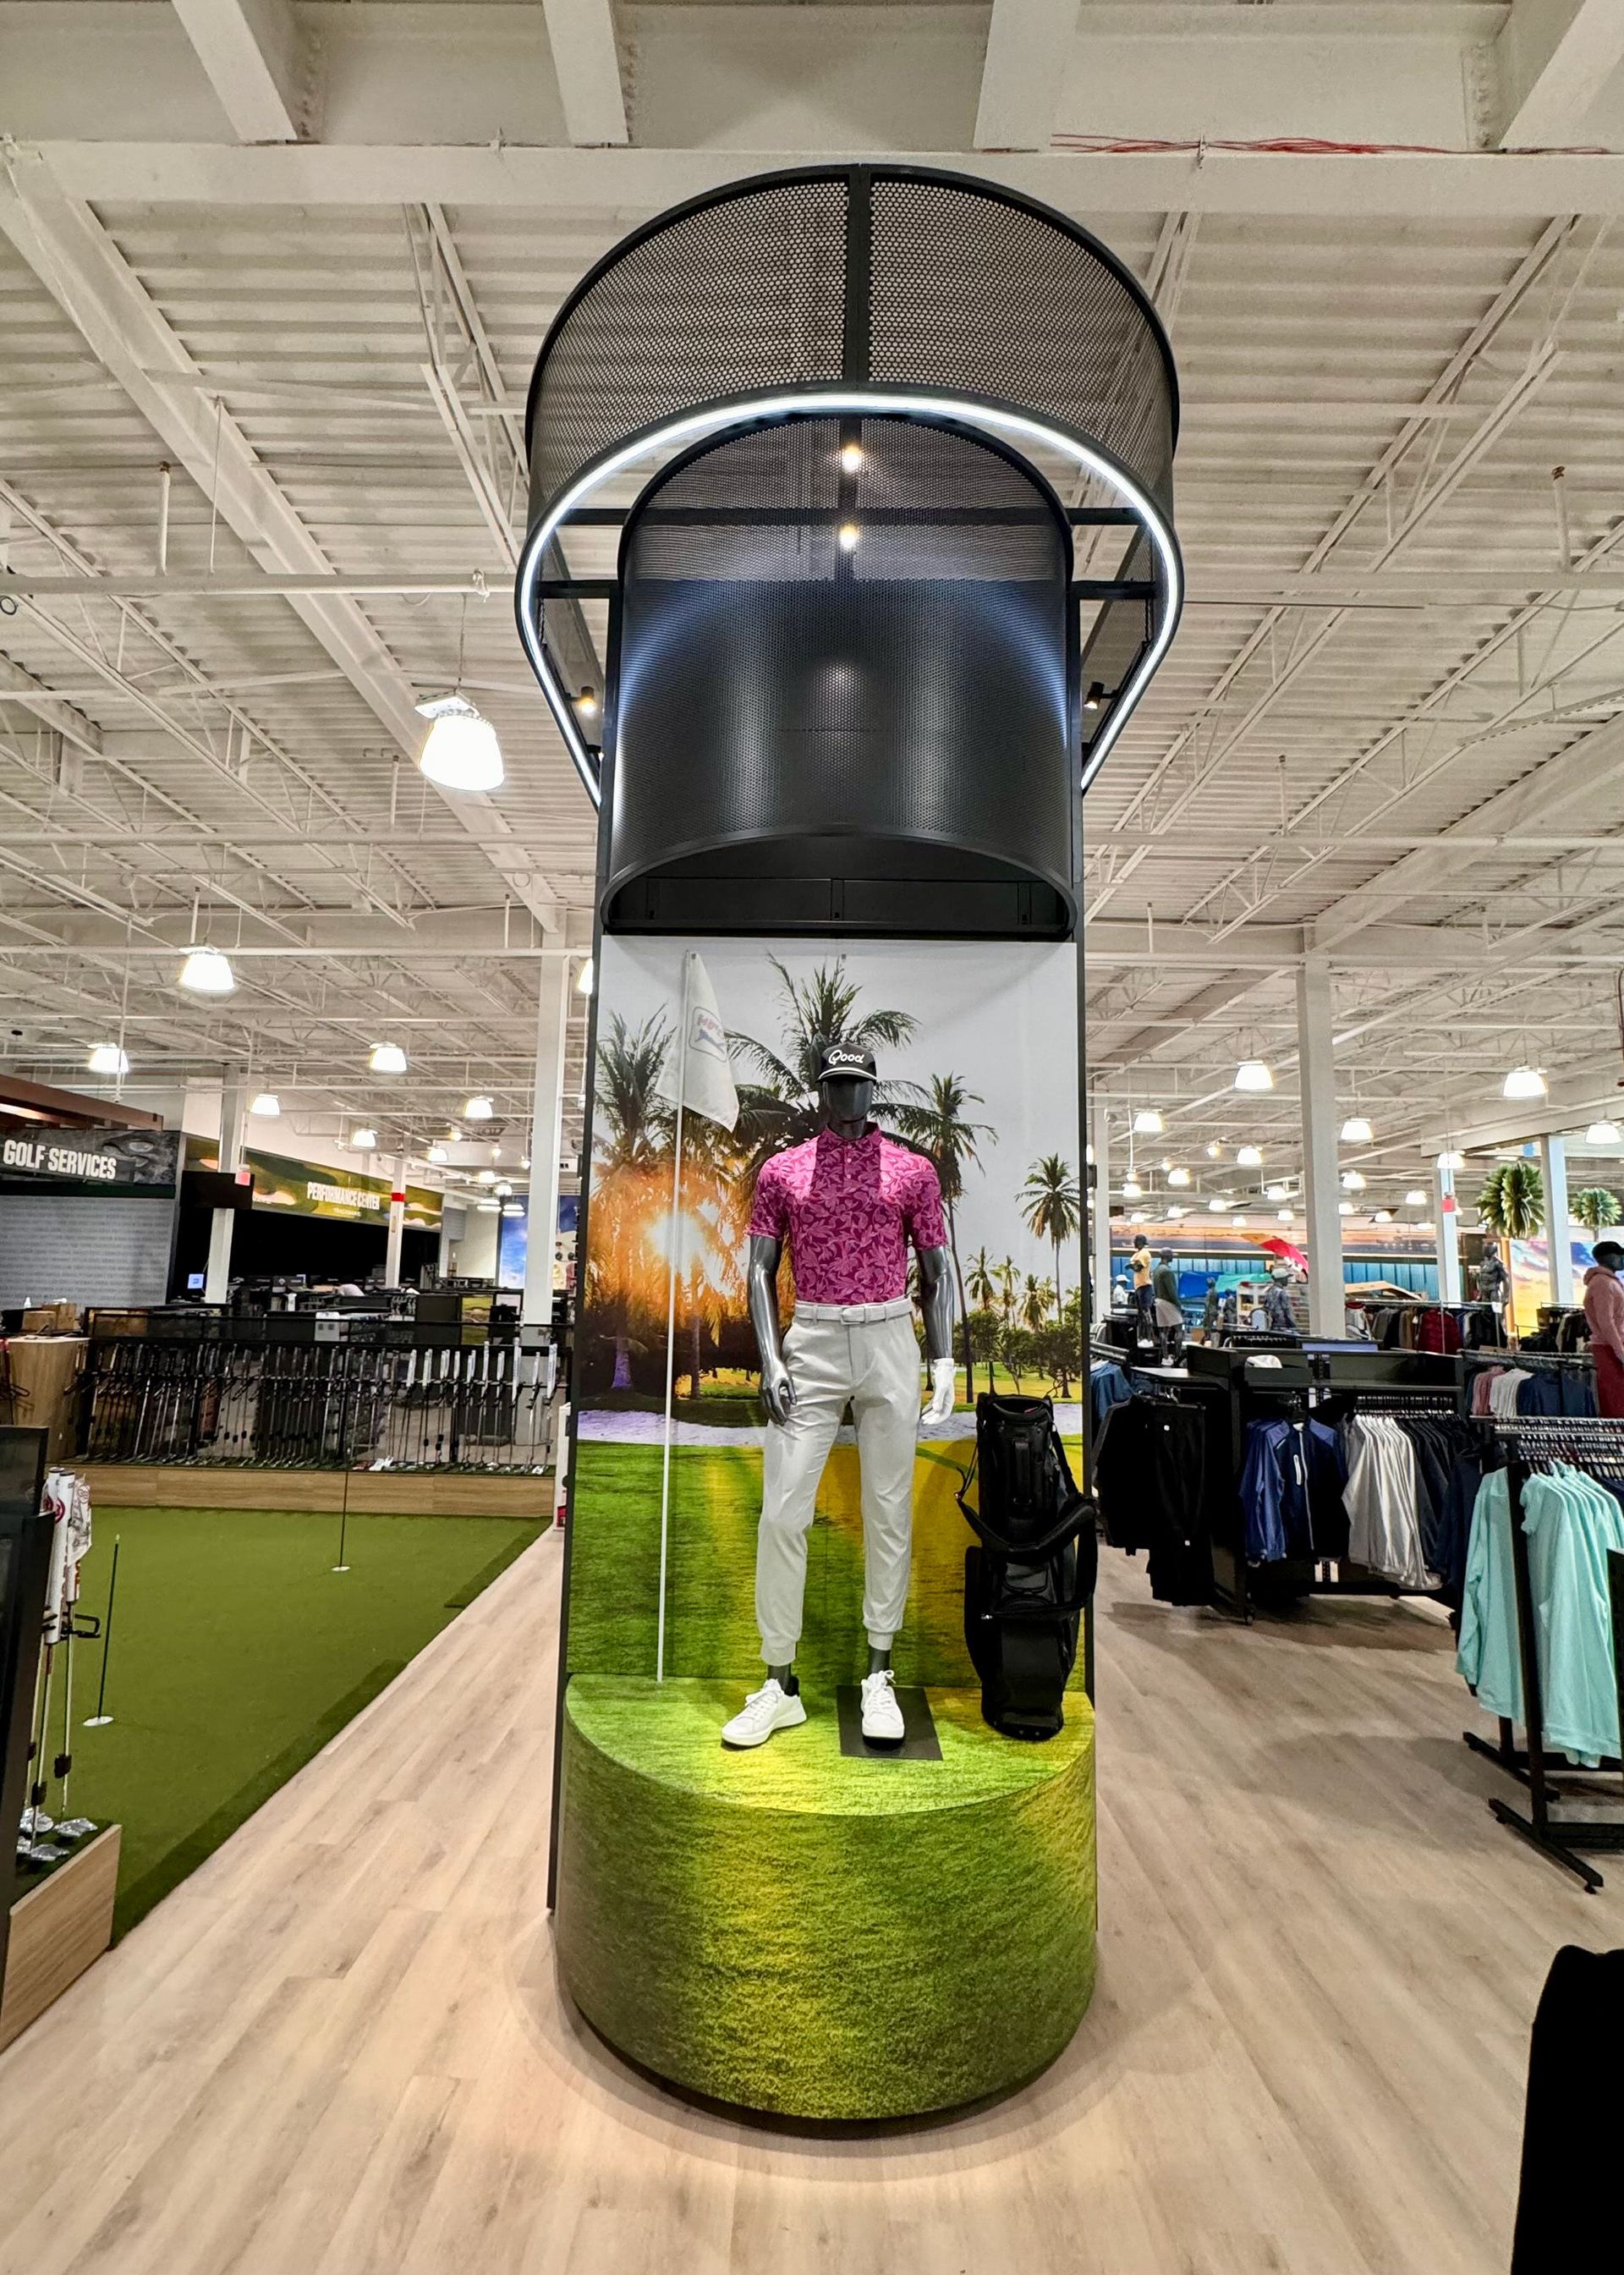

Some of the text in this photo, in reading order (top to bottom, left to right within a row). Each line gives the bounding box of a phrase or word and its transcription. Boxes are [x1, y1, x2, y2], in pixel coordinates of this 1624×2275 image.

[828, 1049, 864, 1065] Good
[3, 1139, 118, 1180] GOLF SERVICES
[307, 1181, 381, 1211] PERFORMANCE CENTER
